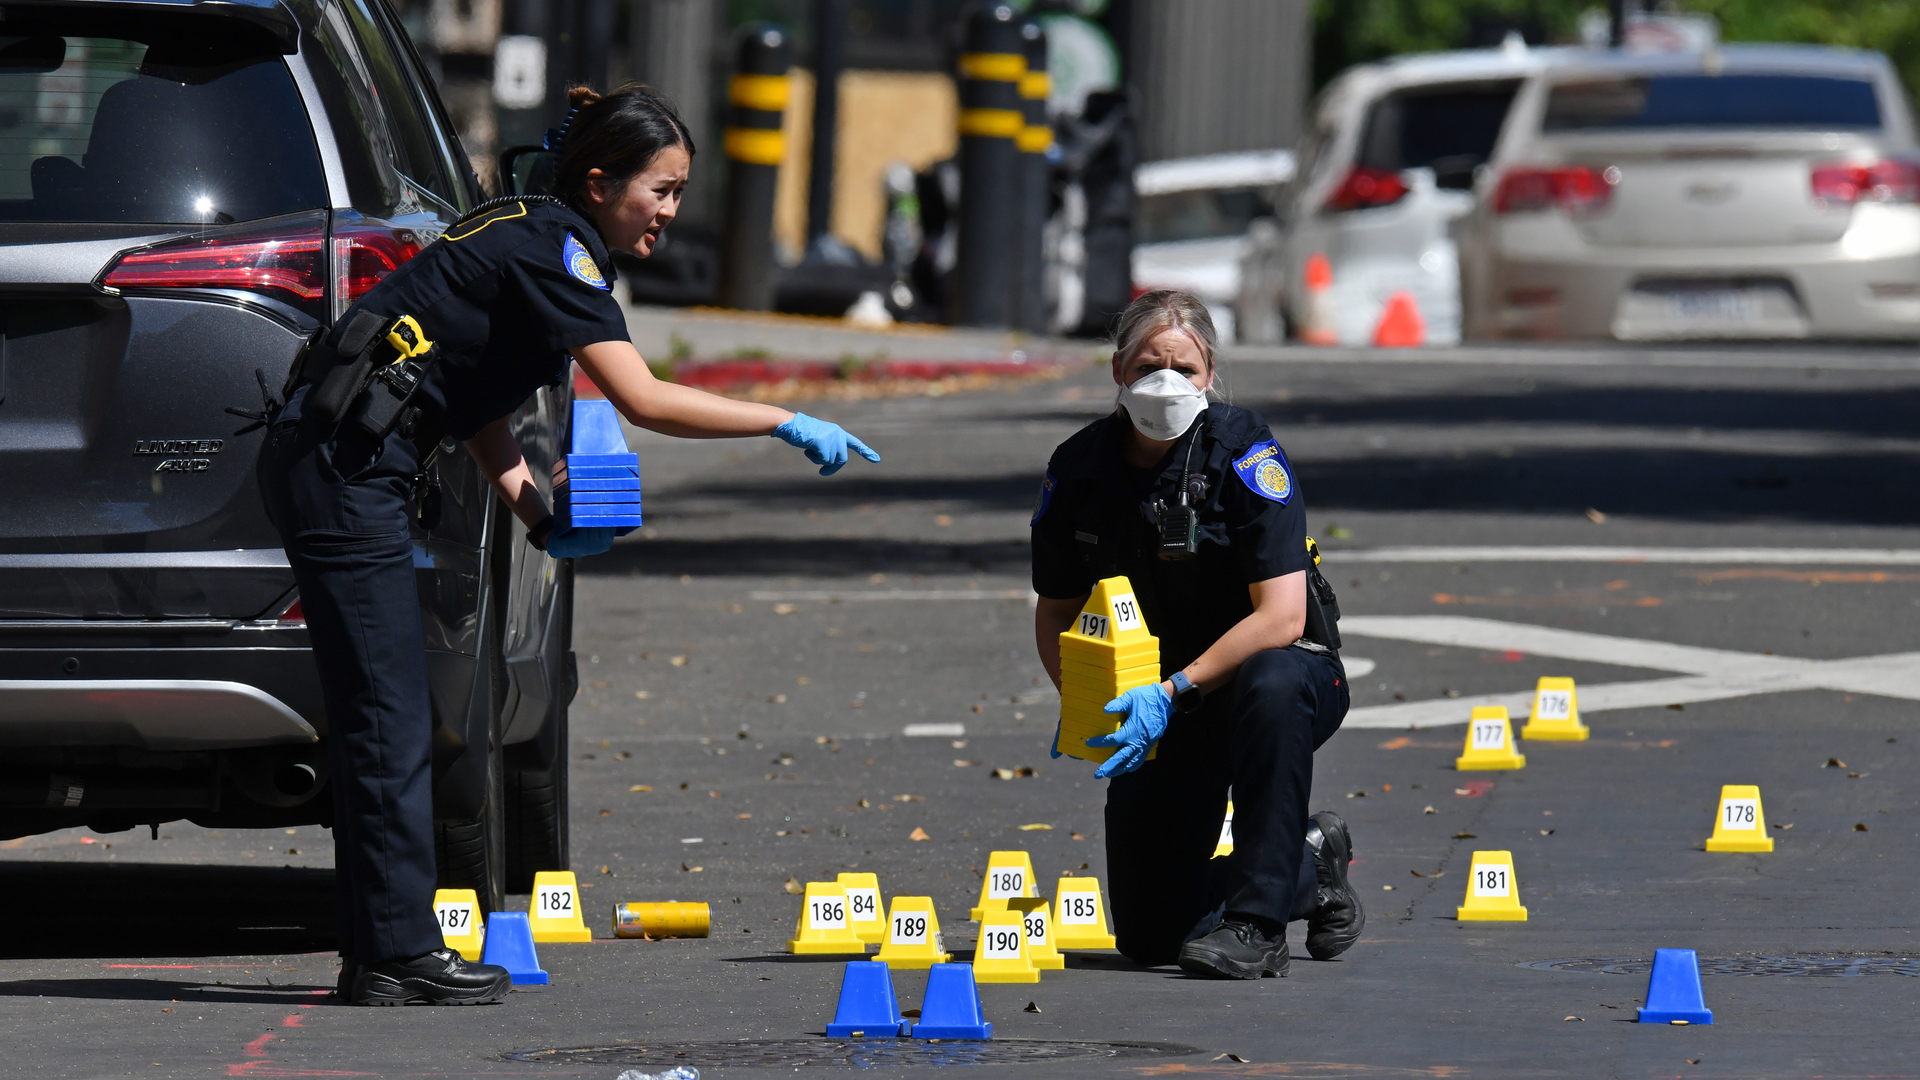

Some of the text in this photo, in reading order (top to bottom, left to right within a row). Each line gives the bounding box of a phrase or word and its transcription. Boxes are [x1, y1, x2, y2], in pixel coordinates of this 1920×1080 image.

[1140, 417, 1154, 429] 3M
[133, 439, 224, 454] LIMITED
[155, 458, 211, 471] AWD
[1237, 445, 1279, 472] FORENSICS
[1114, 600, 1137, 622] 191
[1082, 614, 1106, 638] 191
[1542, 697, 1567, 713] 176
[1477, 725, 1503, 742] 177
[1725, 805, 1754, 823] 178
[992, 873, 1022, 892] 180
[1477, 870, 1506, 889] 181
[541, 891, 572, 911] 182
[847, 895, 875, 914] 84
[1064, 898, 1095, 917] 185
[439, 909, 470, 928] 187
[812, 902, 844, 922] 186
[895, 917, 926, 937] 189
[1024, 918, 1045, 938] 88
[986, 931, 1019, 951] 190
